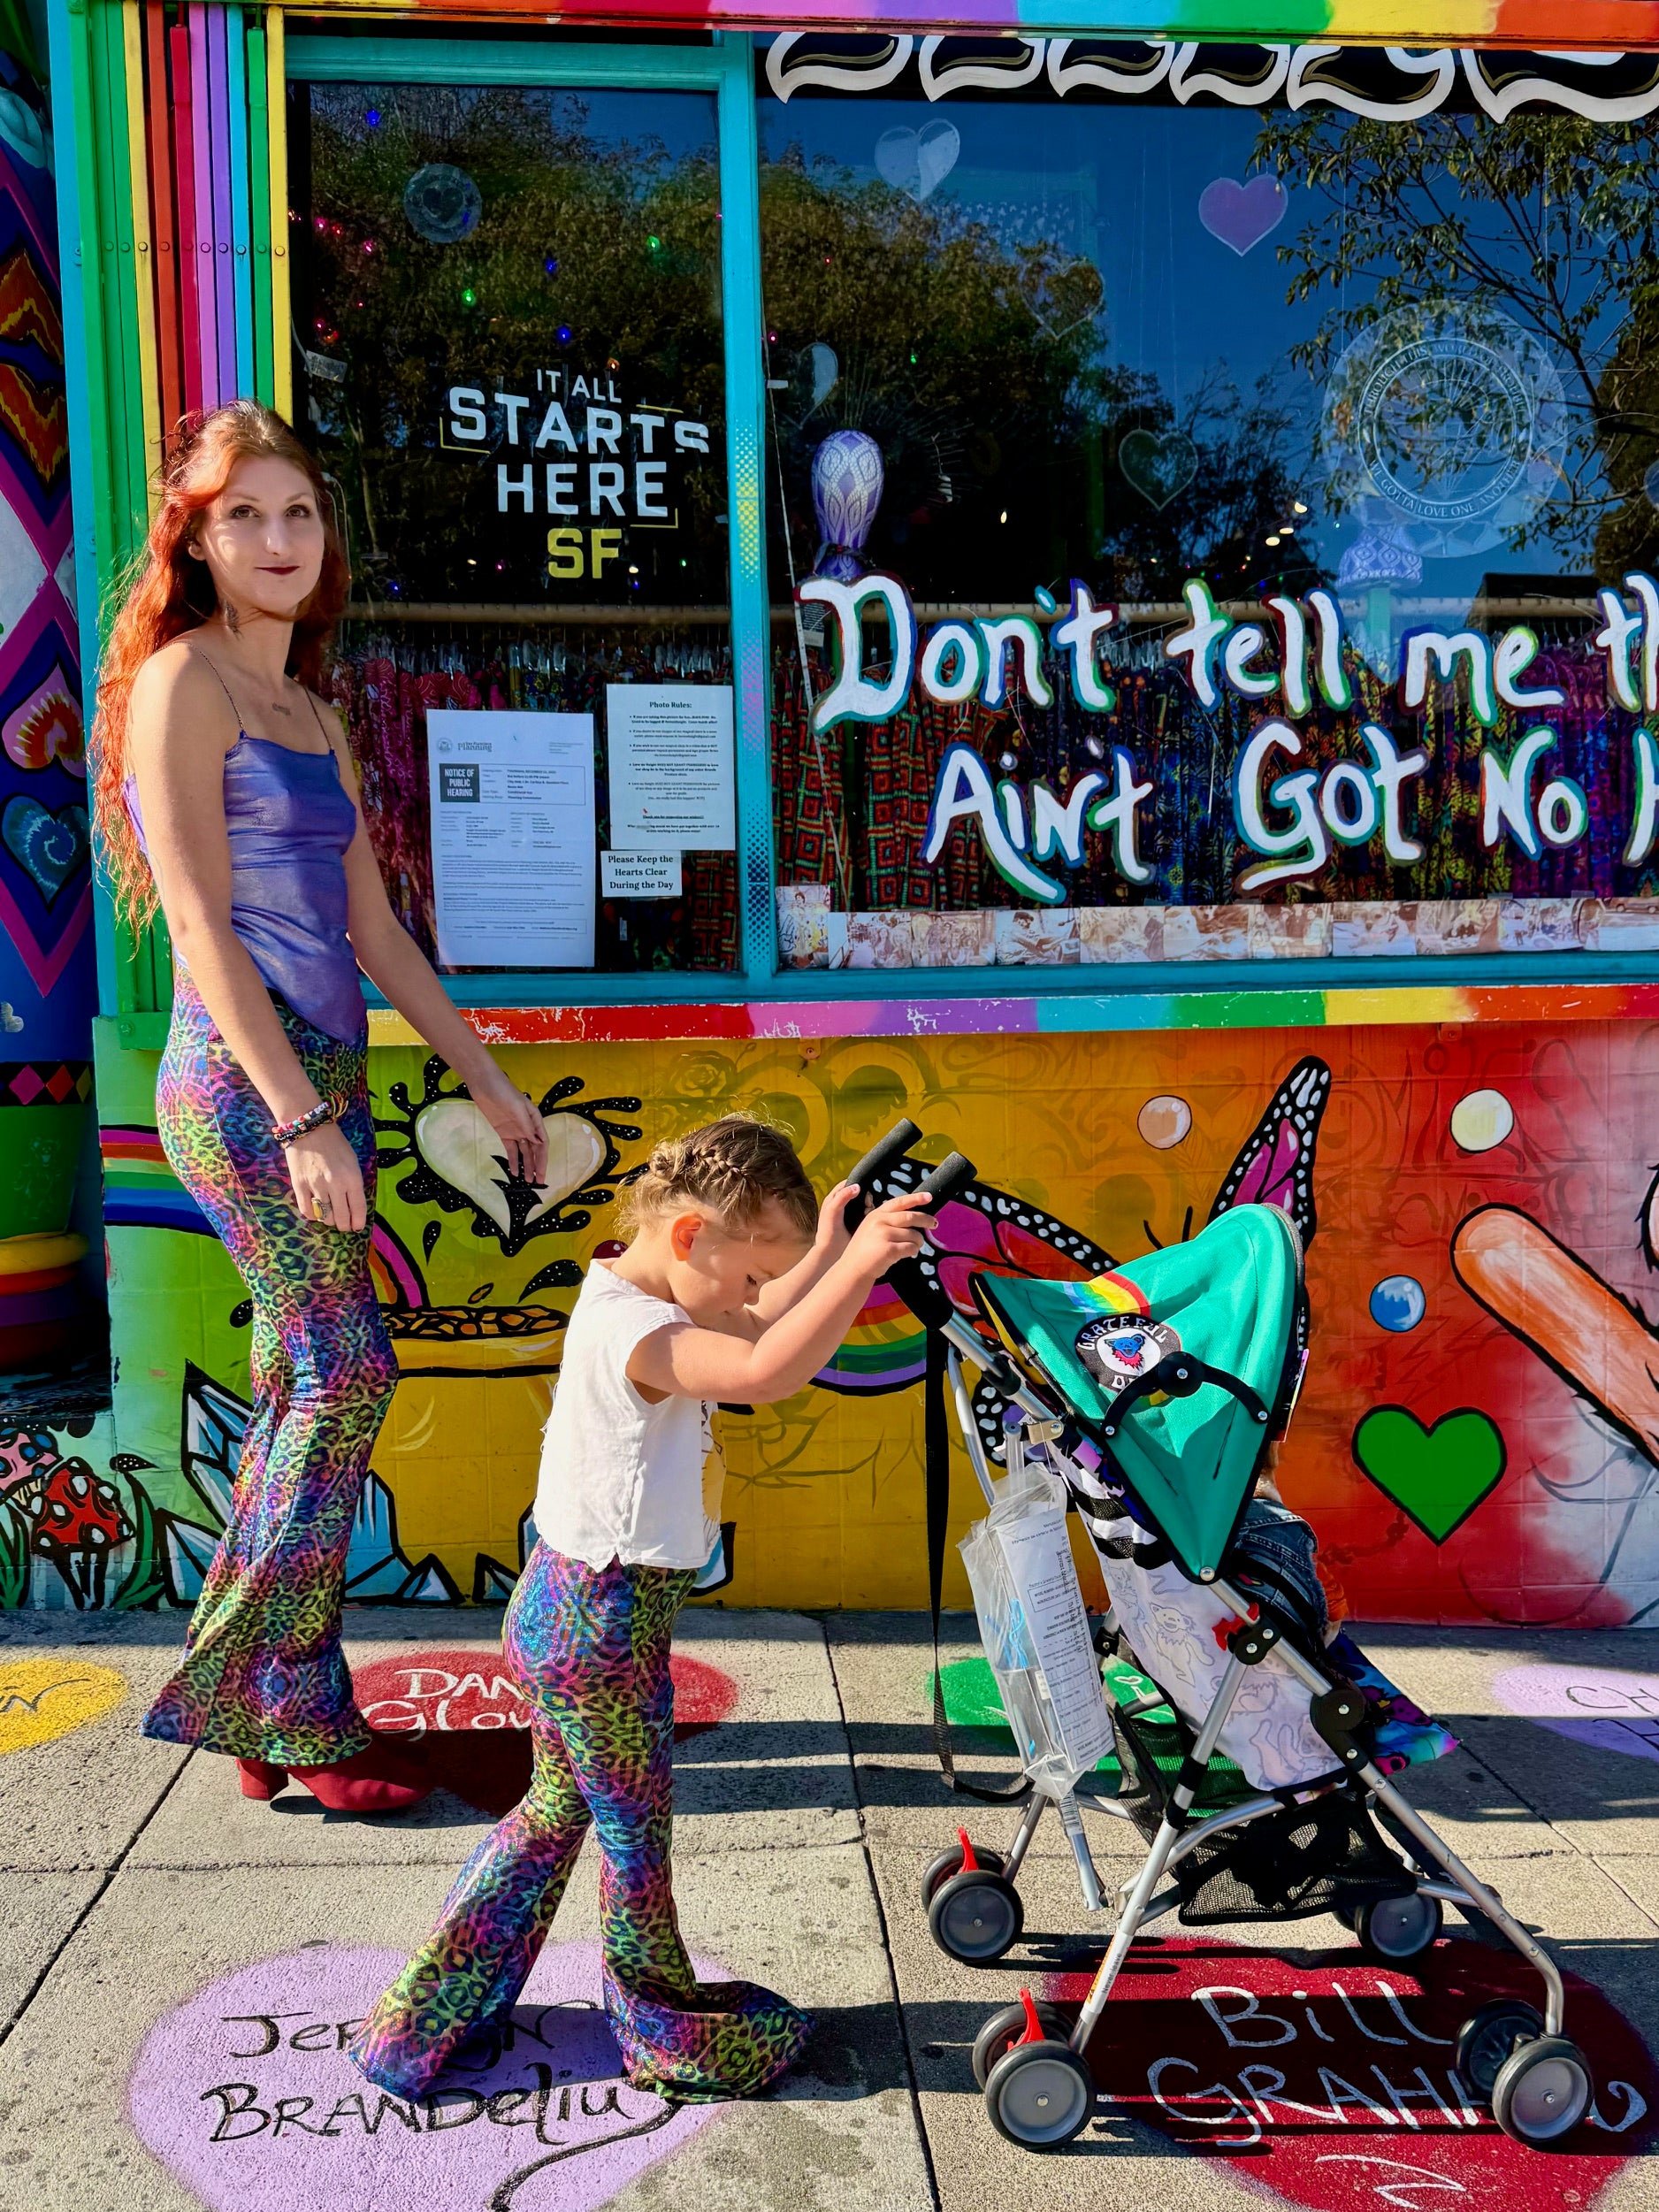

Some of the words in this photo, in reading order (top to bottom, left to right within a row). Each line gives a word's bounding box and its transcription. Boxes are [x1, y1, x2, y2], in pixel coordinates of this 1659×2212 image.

[1402, 343, 1429, 366] THIS
[537, 368, 561, 393] IT
[571, 374, 622, 403] ALL
[449, 386, 709, 454] STARTS
[497, 462, 668, 517] HERE
[1381, 478, 1415, 510] GOTTA
[1418, 504, 1448, 518] LOVE
[1451, 503, 1474, 517] ONE
[1479, 460, 1521, 505] ANOTHER
[547, 528, 622, 578] SF
[794, 570, 1117, 735] Don't
[1163, 578, 1351, 718] tell
[1400, 624, 1570, 726] me
[444, 769, 466, 777] NOTICE
[466, 769, 475, 777] OF
[449, 778, 470, 787] PUBLIC
[447, 788, 473, 797] HEARING
[1234, 716, 1428, 894] Got
[1479, 725, 1589, 861] No
[637, 855, 657, 865] Keep
[609, 881, 640, 891] During
[657, 881, 674, 891] Day
[1076, 1315, 1168, 1351] GRATEFUL
[394, 1668, 525, 1700] DAN
[1191, 1981, 1453, 2047] Bill
[1147, 2056, 1648, 2147] GRAH
